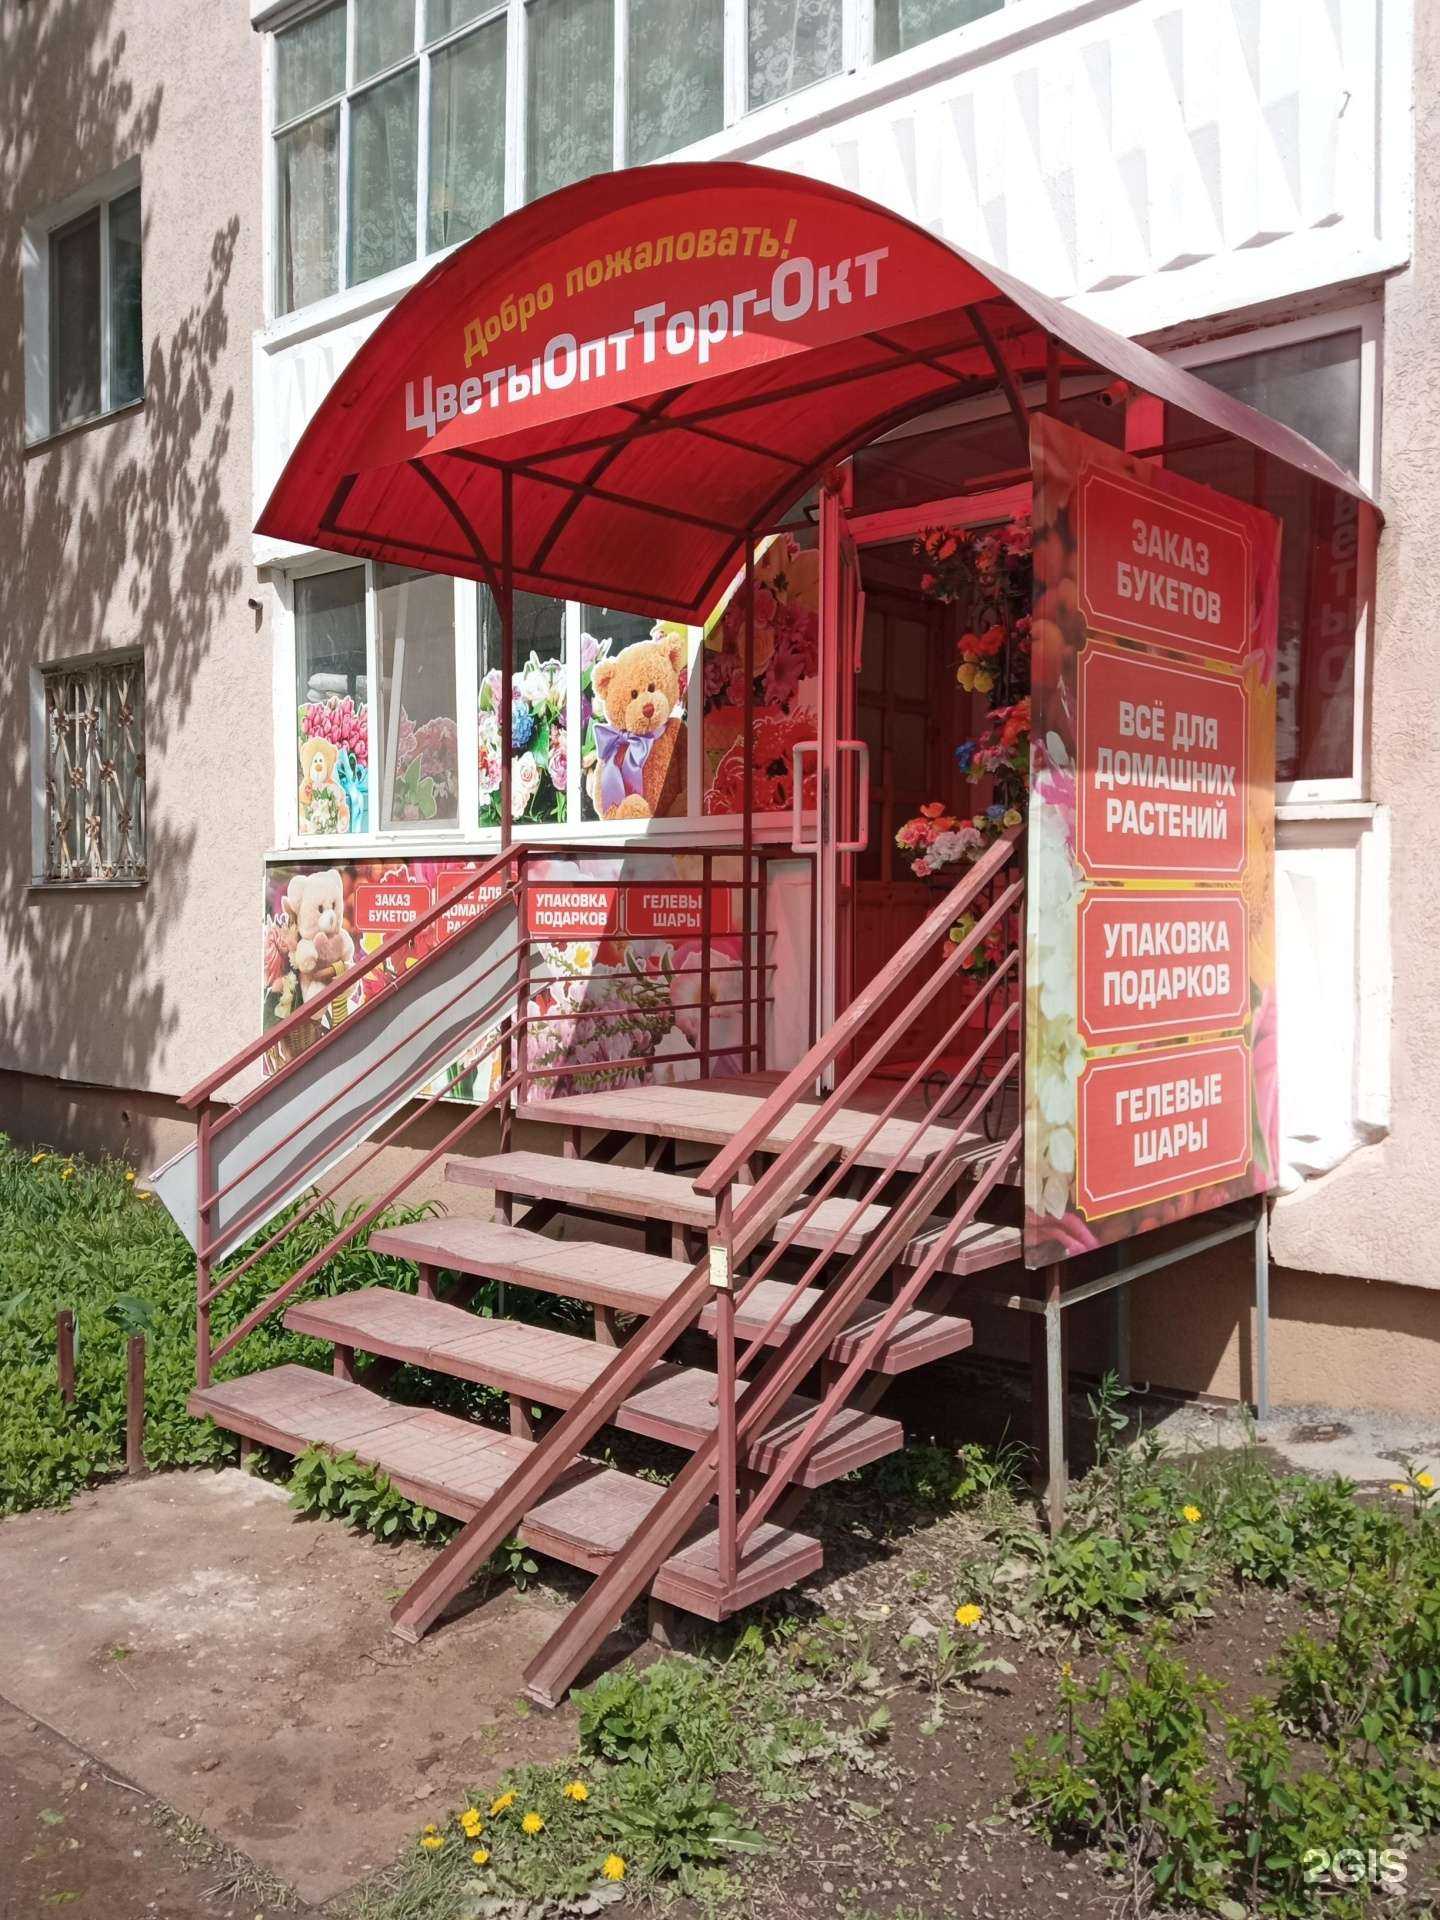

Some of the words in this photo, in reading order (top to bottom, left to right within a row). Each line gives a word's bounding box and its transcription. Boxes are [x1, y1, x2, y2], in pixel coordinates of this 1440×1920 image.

[463, 283, 554, 367] Добро
[565, 218, 798, 298] пожаловать!
[404, 246, 890, 438] ЦветыОптТорг-Окт
[1132, 518, 1210, 577] ЗАКАЗ
[1116, 561, 1222, 624] БУКЕТОВ
[1118, 699, 1165, 743] ВСЁ
[1172, 710, 1219, 751] ДЛЯ
[1094, 747, 1237, 797] ДОМАШНИХ
[1106, 798, 1228, 840] РАСТЕНИЙ
[368, 910, 417, 923] БУКЕТОВ
[374, 893, 411, 907] ЗАКАЗ
[535, 893, 608, 909] УПАКОВКА
[535, 911, 608, 927] ПОДАРКОВ
[643, 894, 703, 909] ГЕЛЕВЫ
[653, 912, 701, 927] ШАРЫ
[1103, 920, 1230, 958] УПАКОВКА
[1103, 964, 1230, 1010] ПОДАРКОВ
[1115, 1073, 1223, 1126] ГЕЛЕВЫЕ
[1133, 1118, 1209, 1167] ШАРЫ
